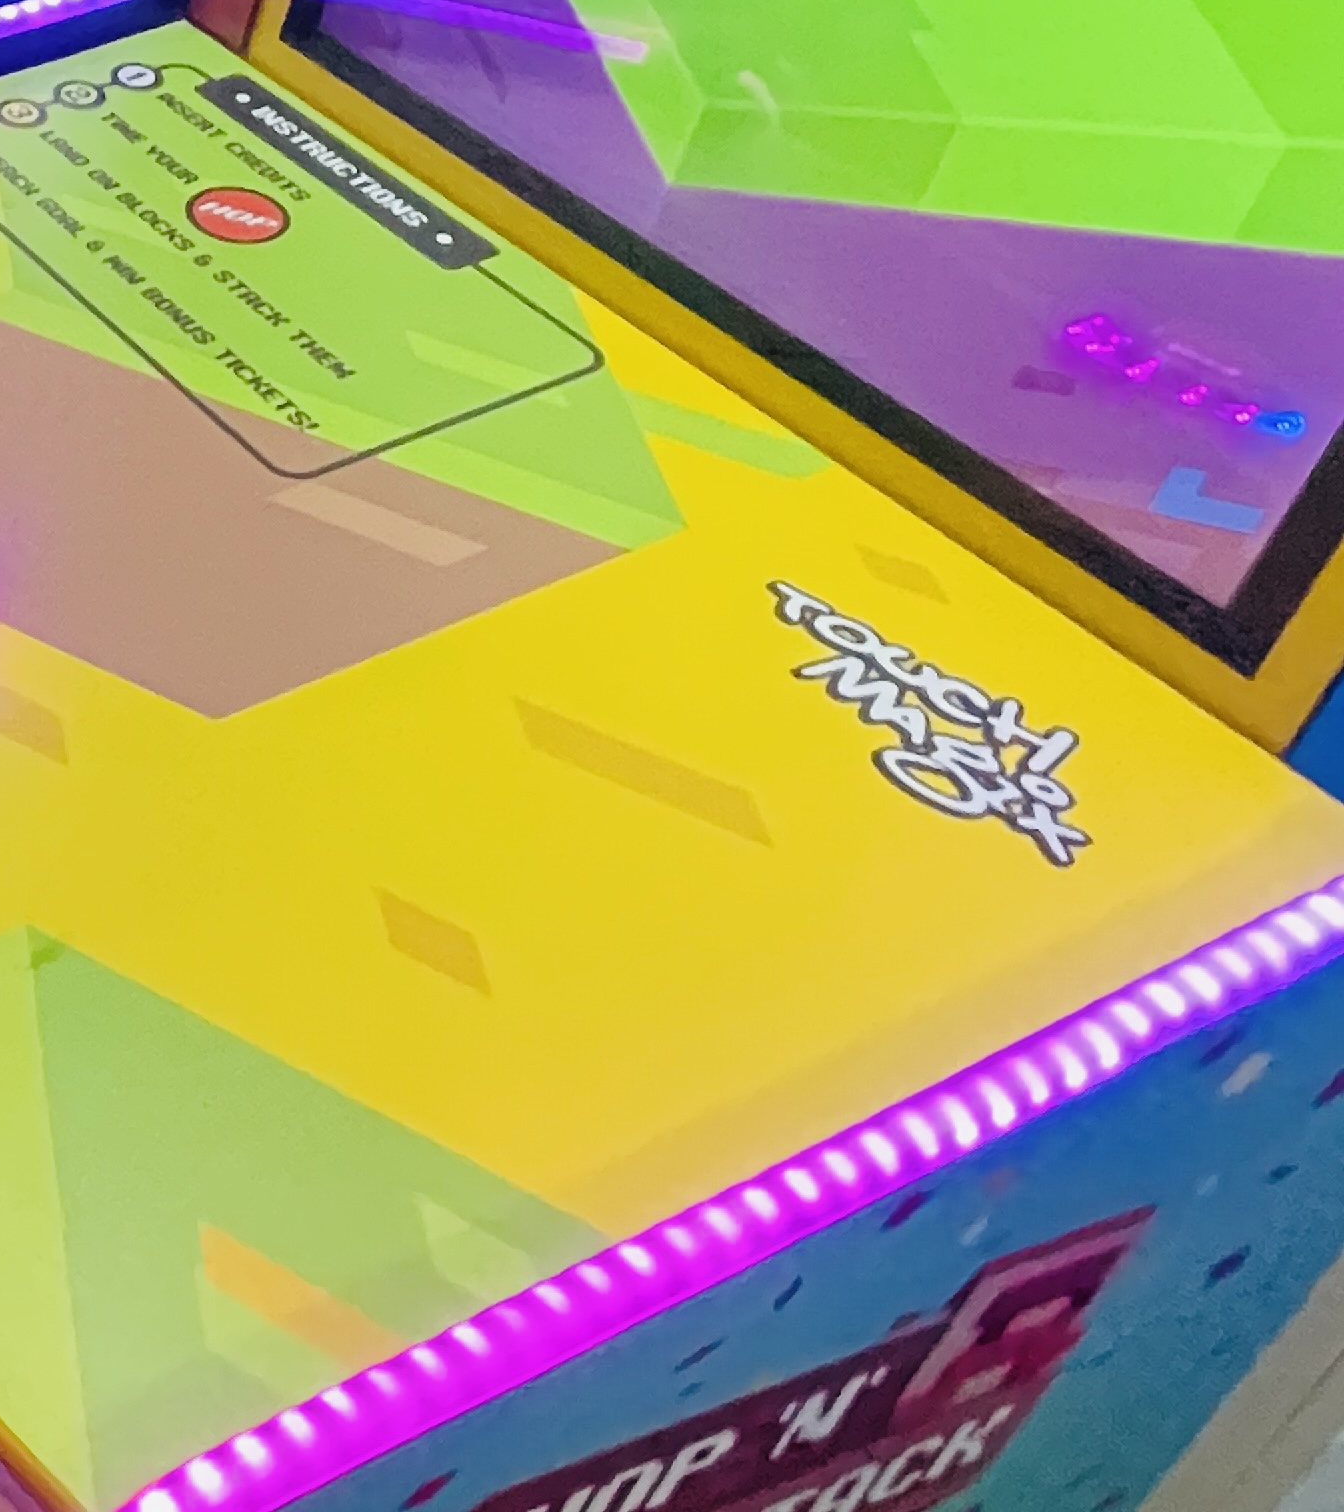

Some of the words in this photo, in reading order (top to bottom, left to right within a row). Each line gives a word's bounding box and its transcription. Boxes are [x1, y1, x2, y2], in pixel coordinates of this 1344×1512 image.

[146, 144, 199, 185] YOUR
[157, 92, 228, 139] INSERT
[224, 141, 312, 202] CREDITS
[250, 103, 429, 228] INSTRUCTIONS
[115, 192, 196, 251] BLOCKS
[213, 269, 291, 327] STACK
[288, 328, 357, 379] THEM
[140, 286, 216, 345] BONUS
[215, 346, 321, 430] TICKETS!
